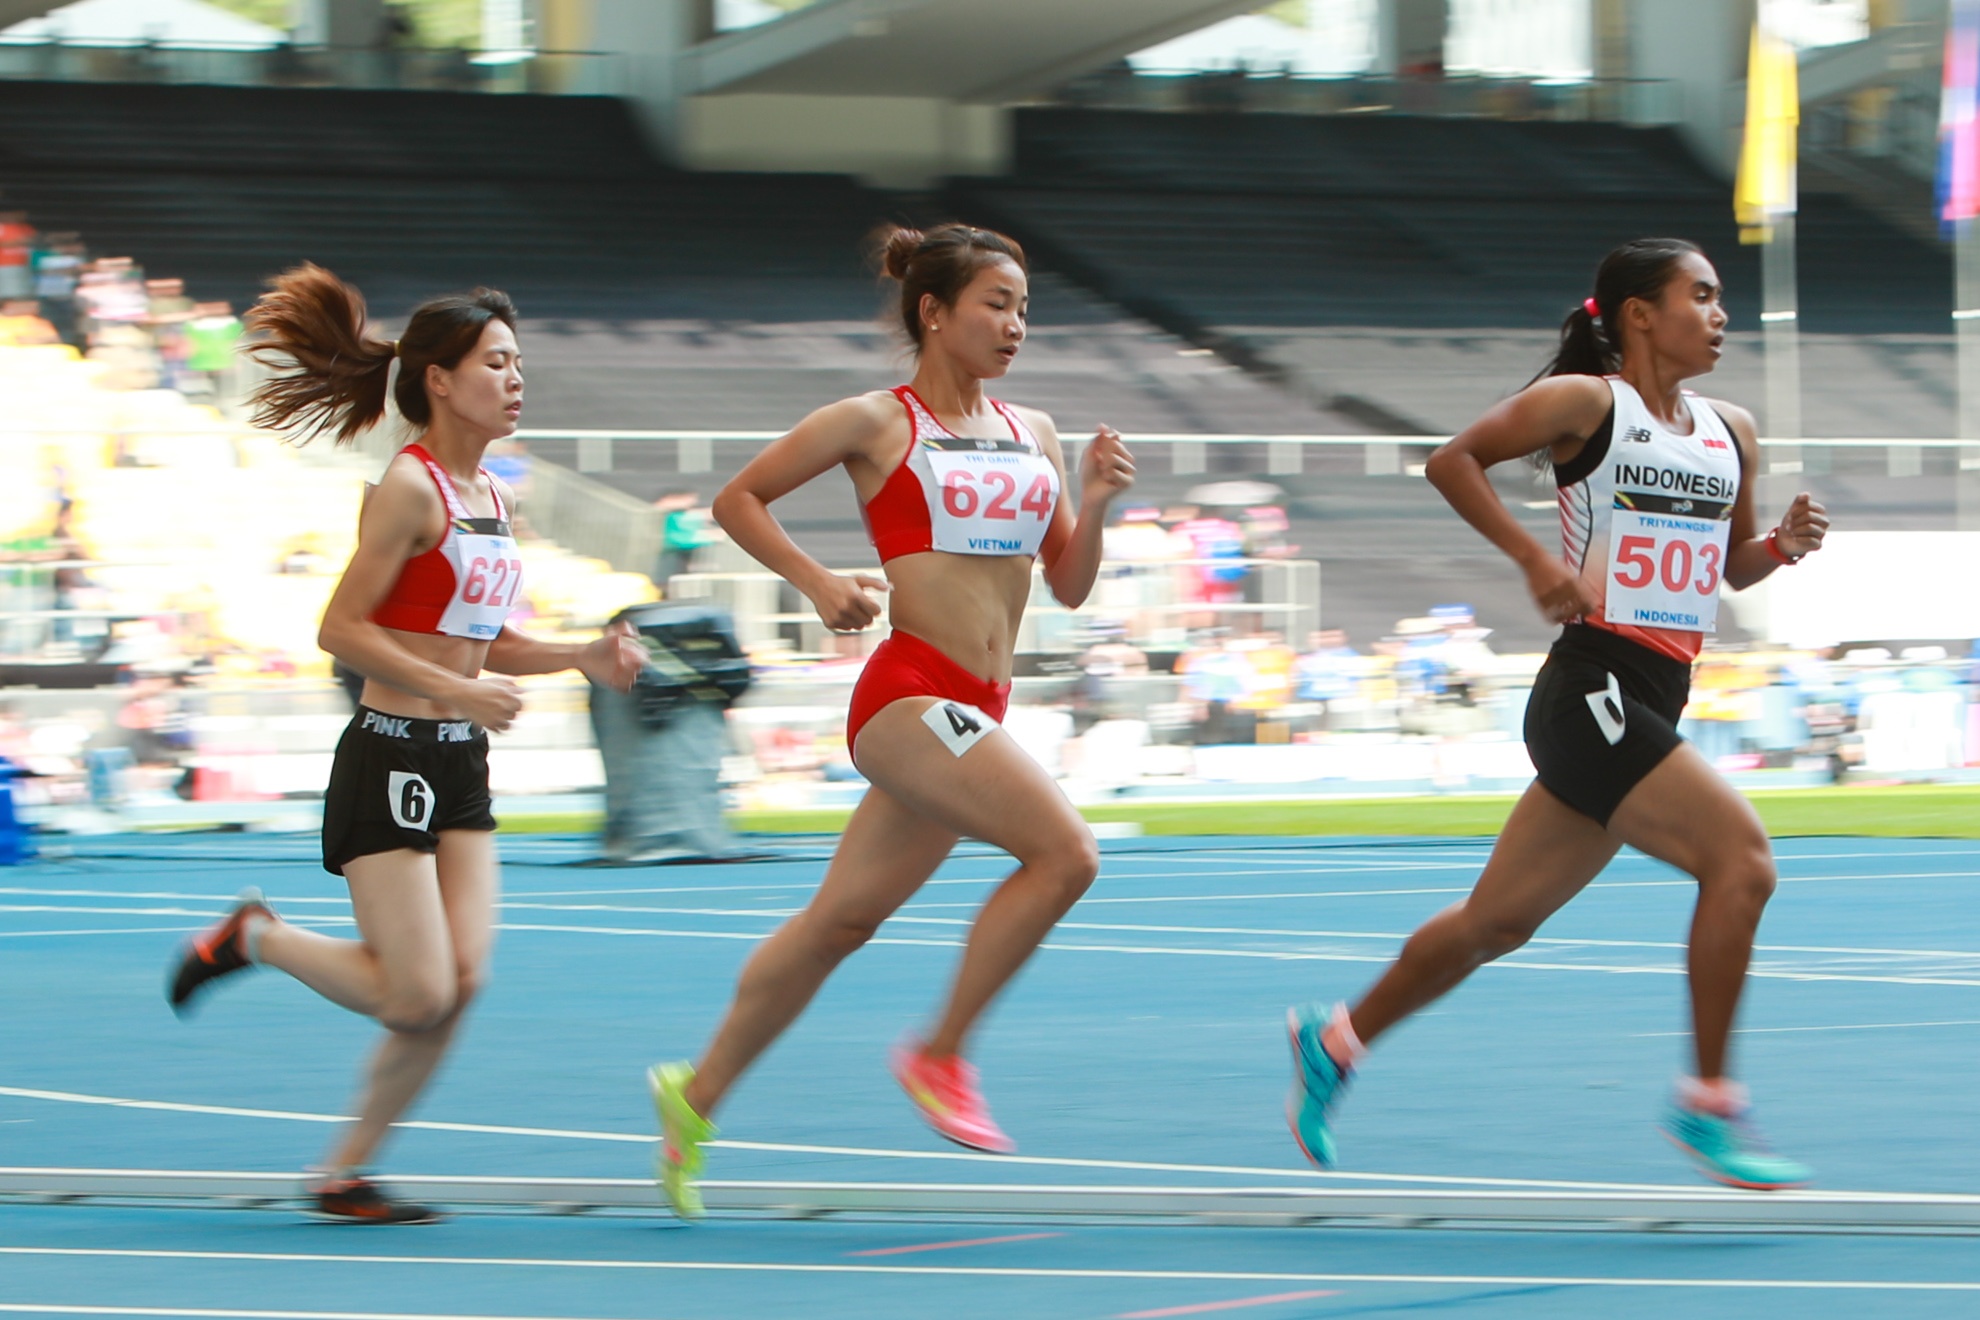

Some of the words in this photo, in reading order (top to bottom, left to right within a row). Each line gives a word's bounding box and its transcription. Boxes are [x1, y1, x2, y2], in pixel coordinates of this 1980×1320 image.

[943, 470, 1052, 522] 624
[1615, 464, 1734, 499] INDONESIA
[968, 538, 1022, 551] VIETNAM
[463, 556, 522, 608] 627
[1613, 535, 1720, 596] 503
[1634, 609, 1699, 626] INDONESIA
[361, 711, 413, 739] PINK
[437, 721, 473, 742] PINK
[943, 702, 982, 738] 4
[401, 779, 426, 824] 6
